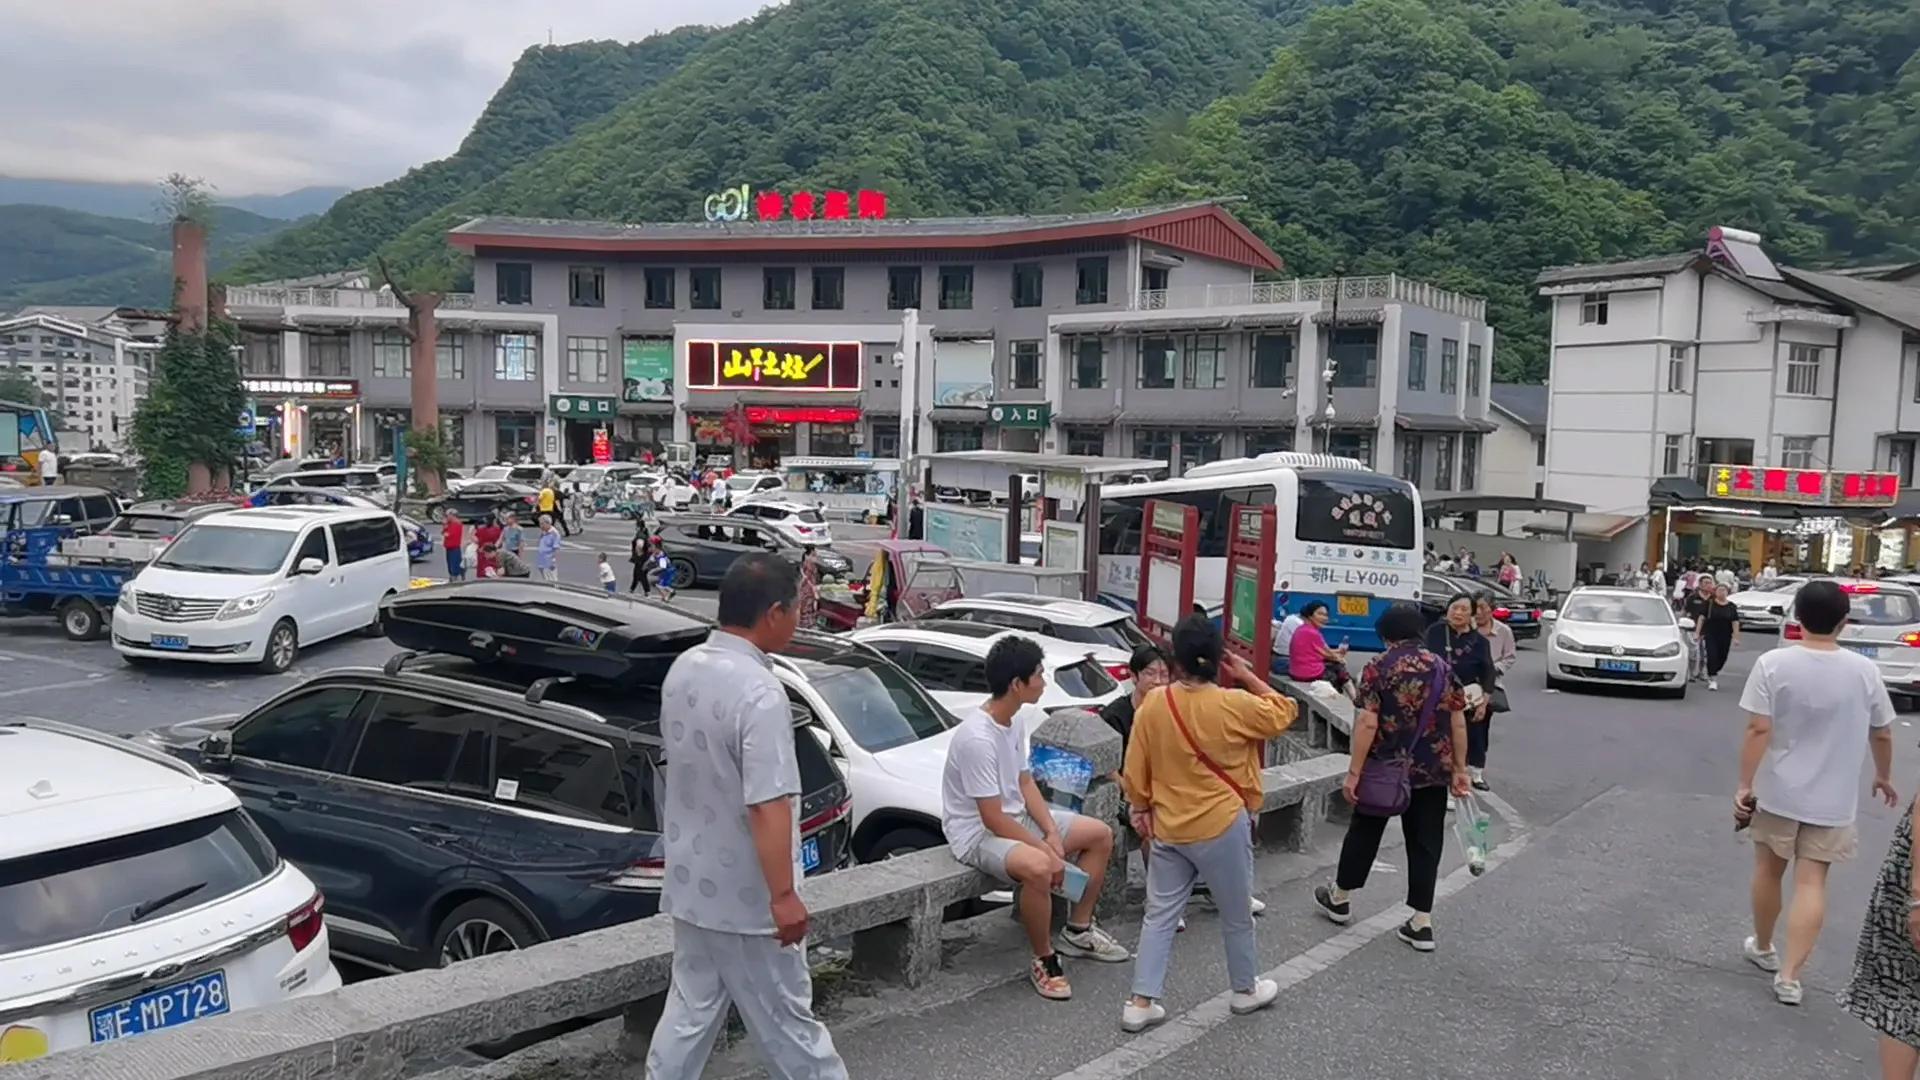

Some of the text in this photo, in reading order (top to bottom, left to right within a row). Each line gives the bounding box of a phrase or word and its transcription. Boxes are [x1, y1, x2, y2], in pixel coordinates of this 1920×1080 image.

[578, 399, 609, 412] 出口
[1010, 407, 1038, 421] 入口
[1345, 570, 1400, 586] LY000
